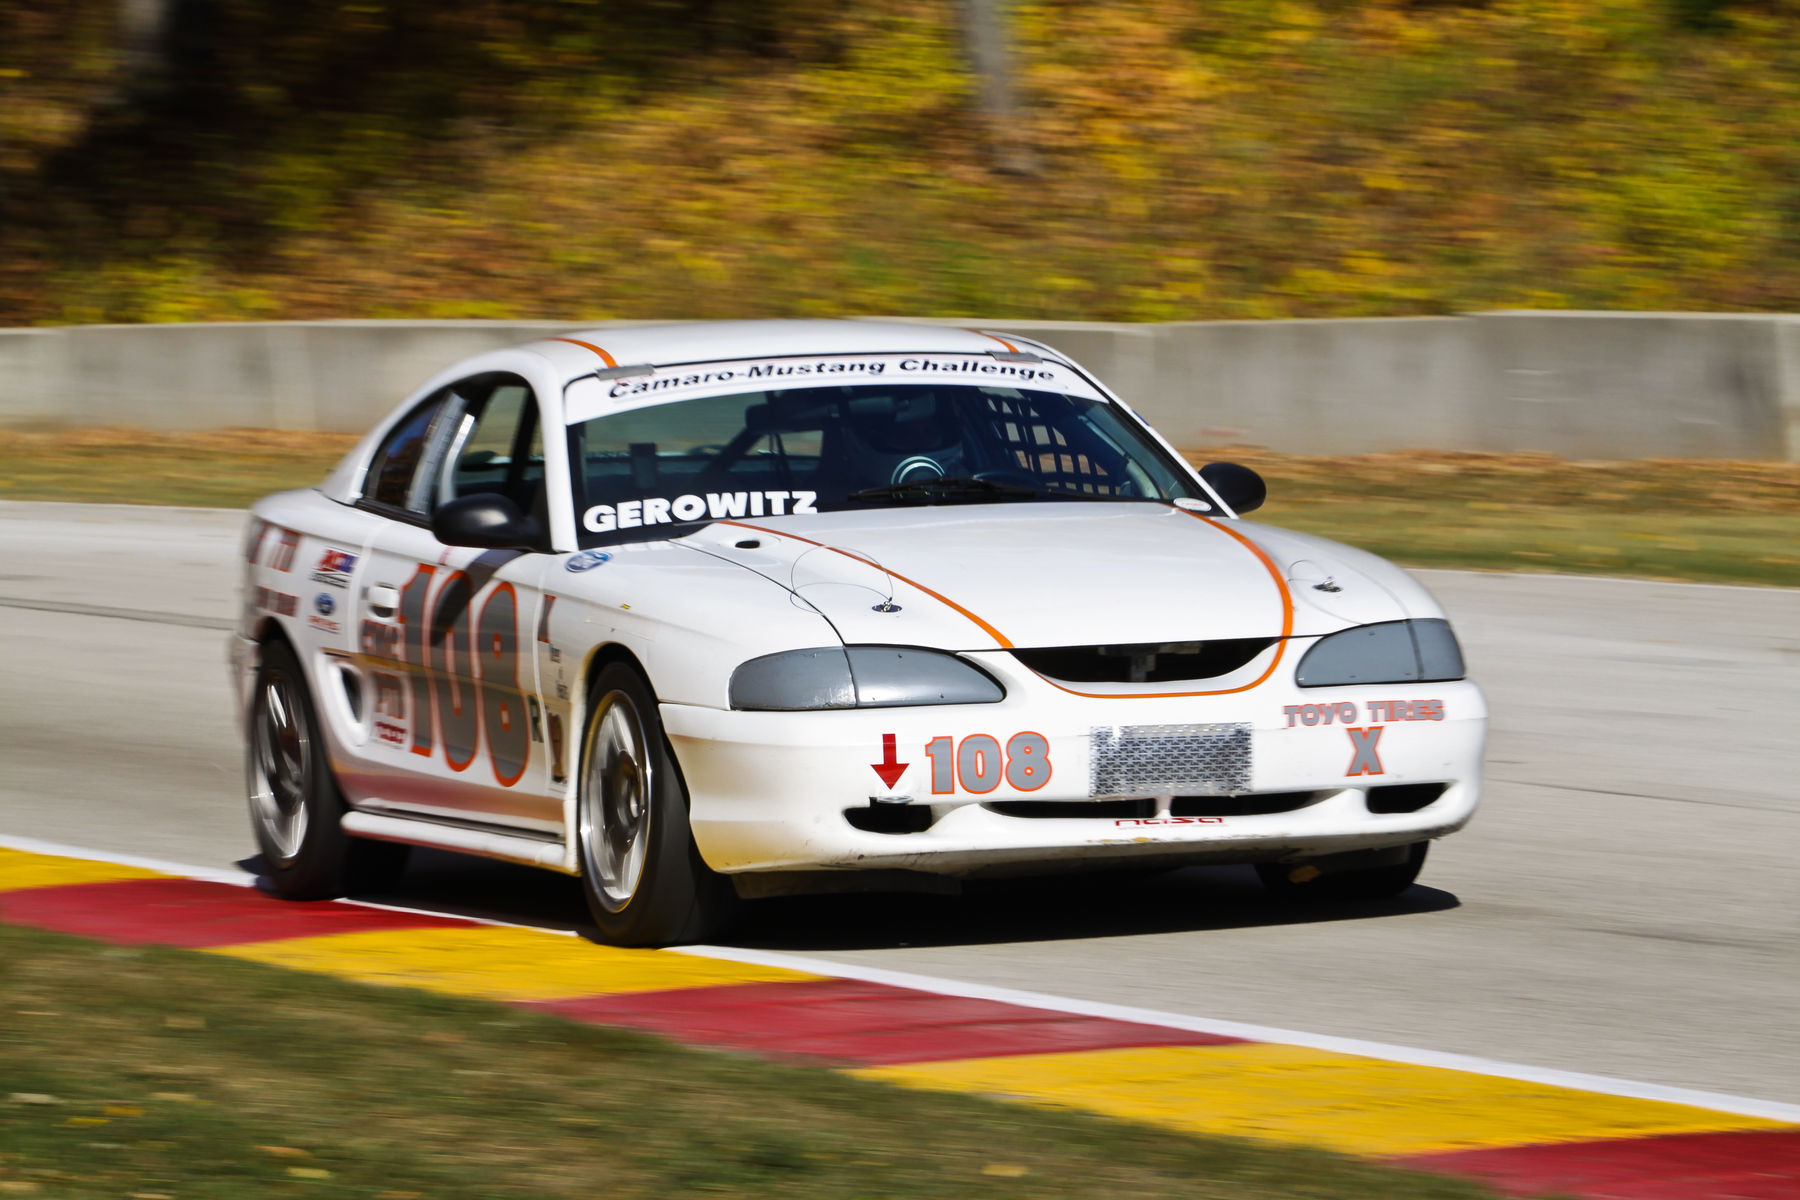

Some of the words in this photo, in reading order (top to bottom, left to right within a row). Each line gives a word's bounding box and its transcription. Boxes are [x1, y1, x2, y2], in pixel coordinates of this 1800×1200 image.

[608, 361, 886, 399] Camaro-Mustang
[899, 358, 1055, 381] Challenge
[583, 490, 818, 533] GEROWITZ
[397, 562, 531, 788] 108
[1283, 701, 1358, 728] TOYO
[1367, 699, 1445, 722] TIRES
[924, 731, 1053, 795] 108
[1344, 725, 1385, 777] X
